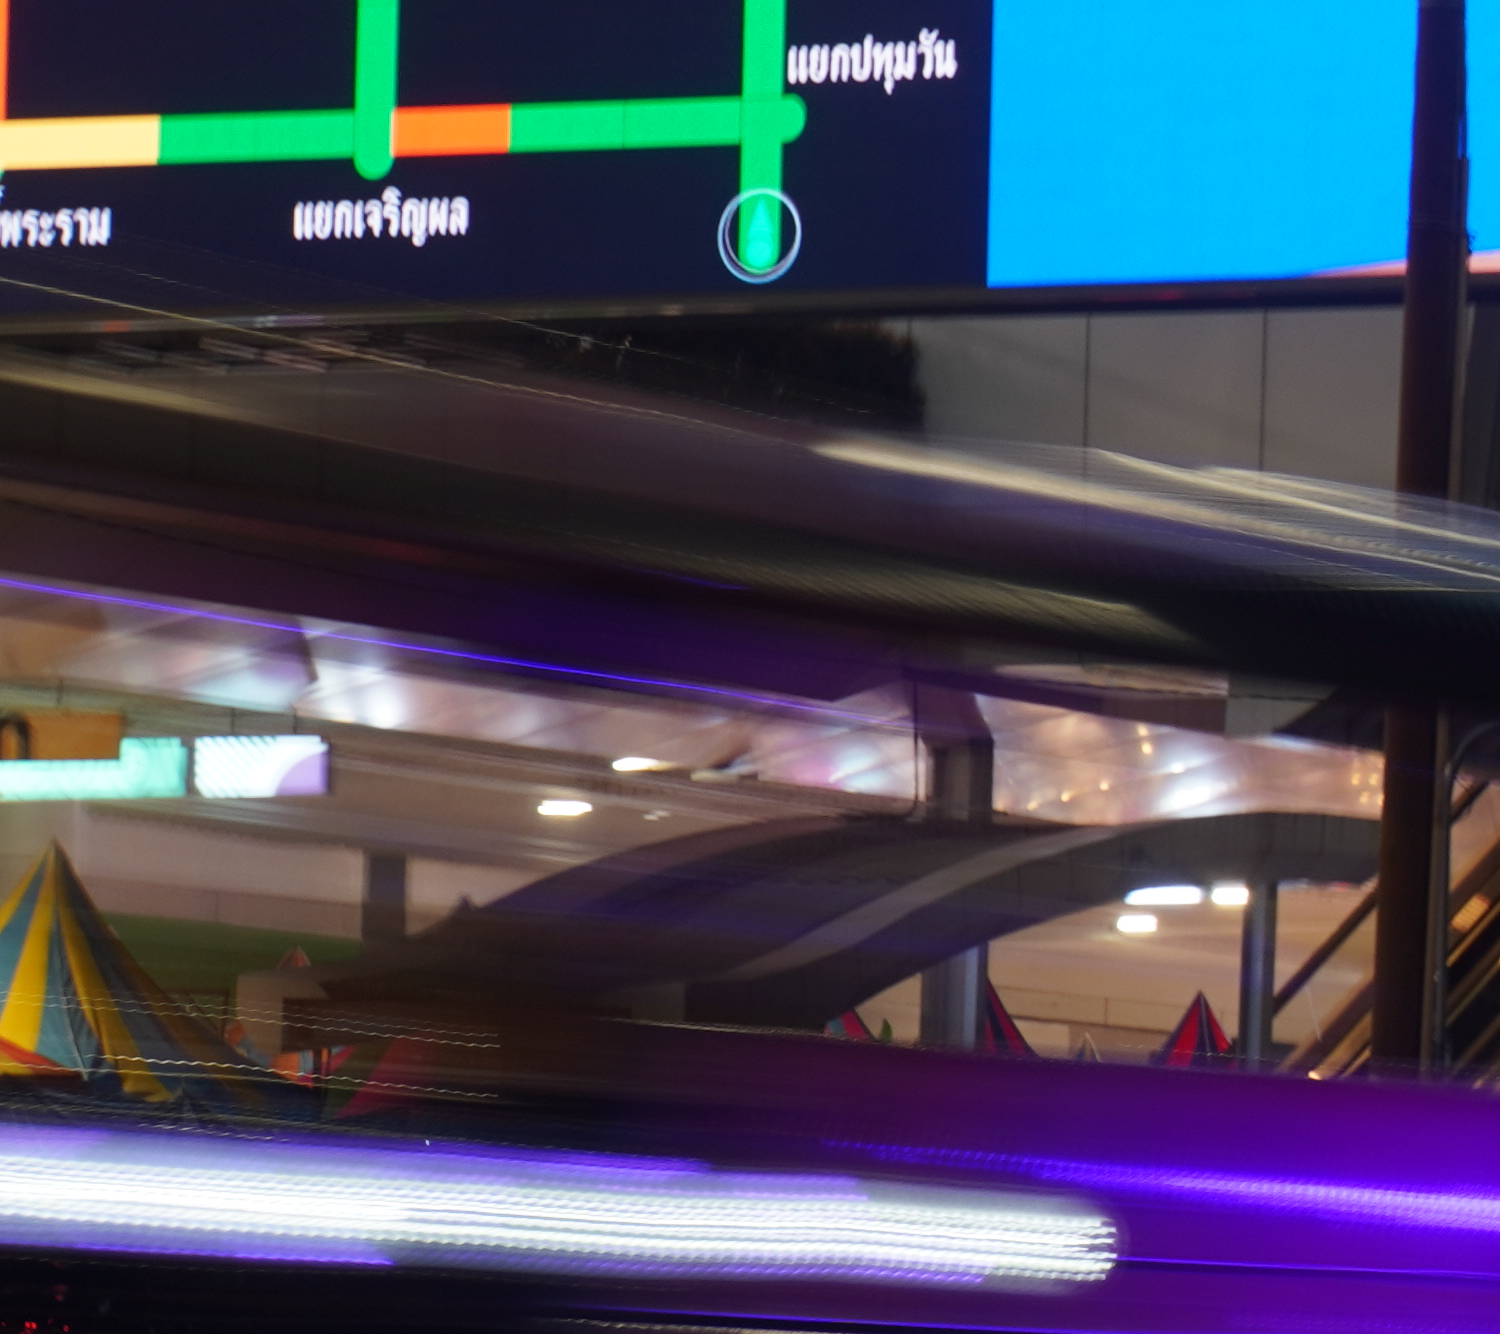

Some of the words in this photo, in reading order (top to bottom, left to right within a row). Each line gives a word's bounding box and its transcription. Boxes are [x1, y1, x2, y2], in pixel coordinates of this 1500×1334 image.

[786, 27, 958, 97] แยกปทุมวัน
[292, 184, 471, 249] แยกเจริญผล
